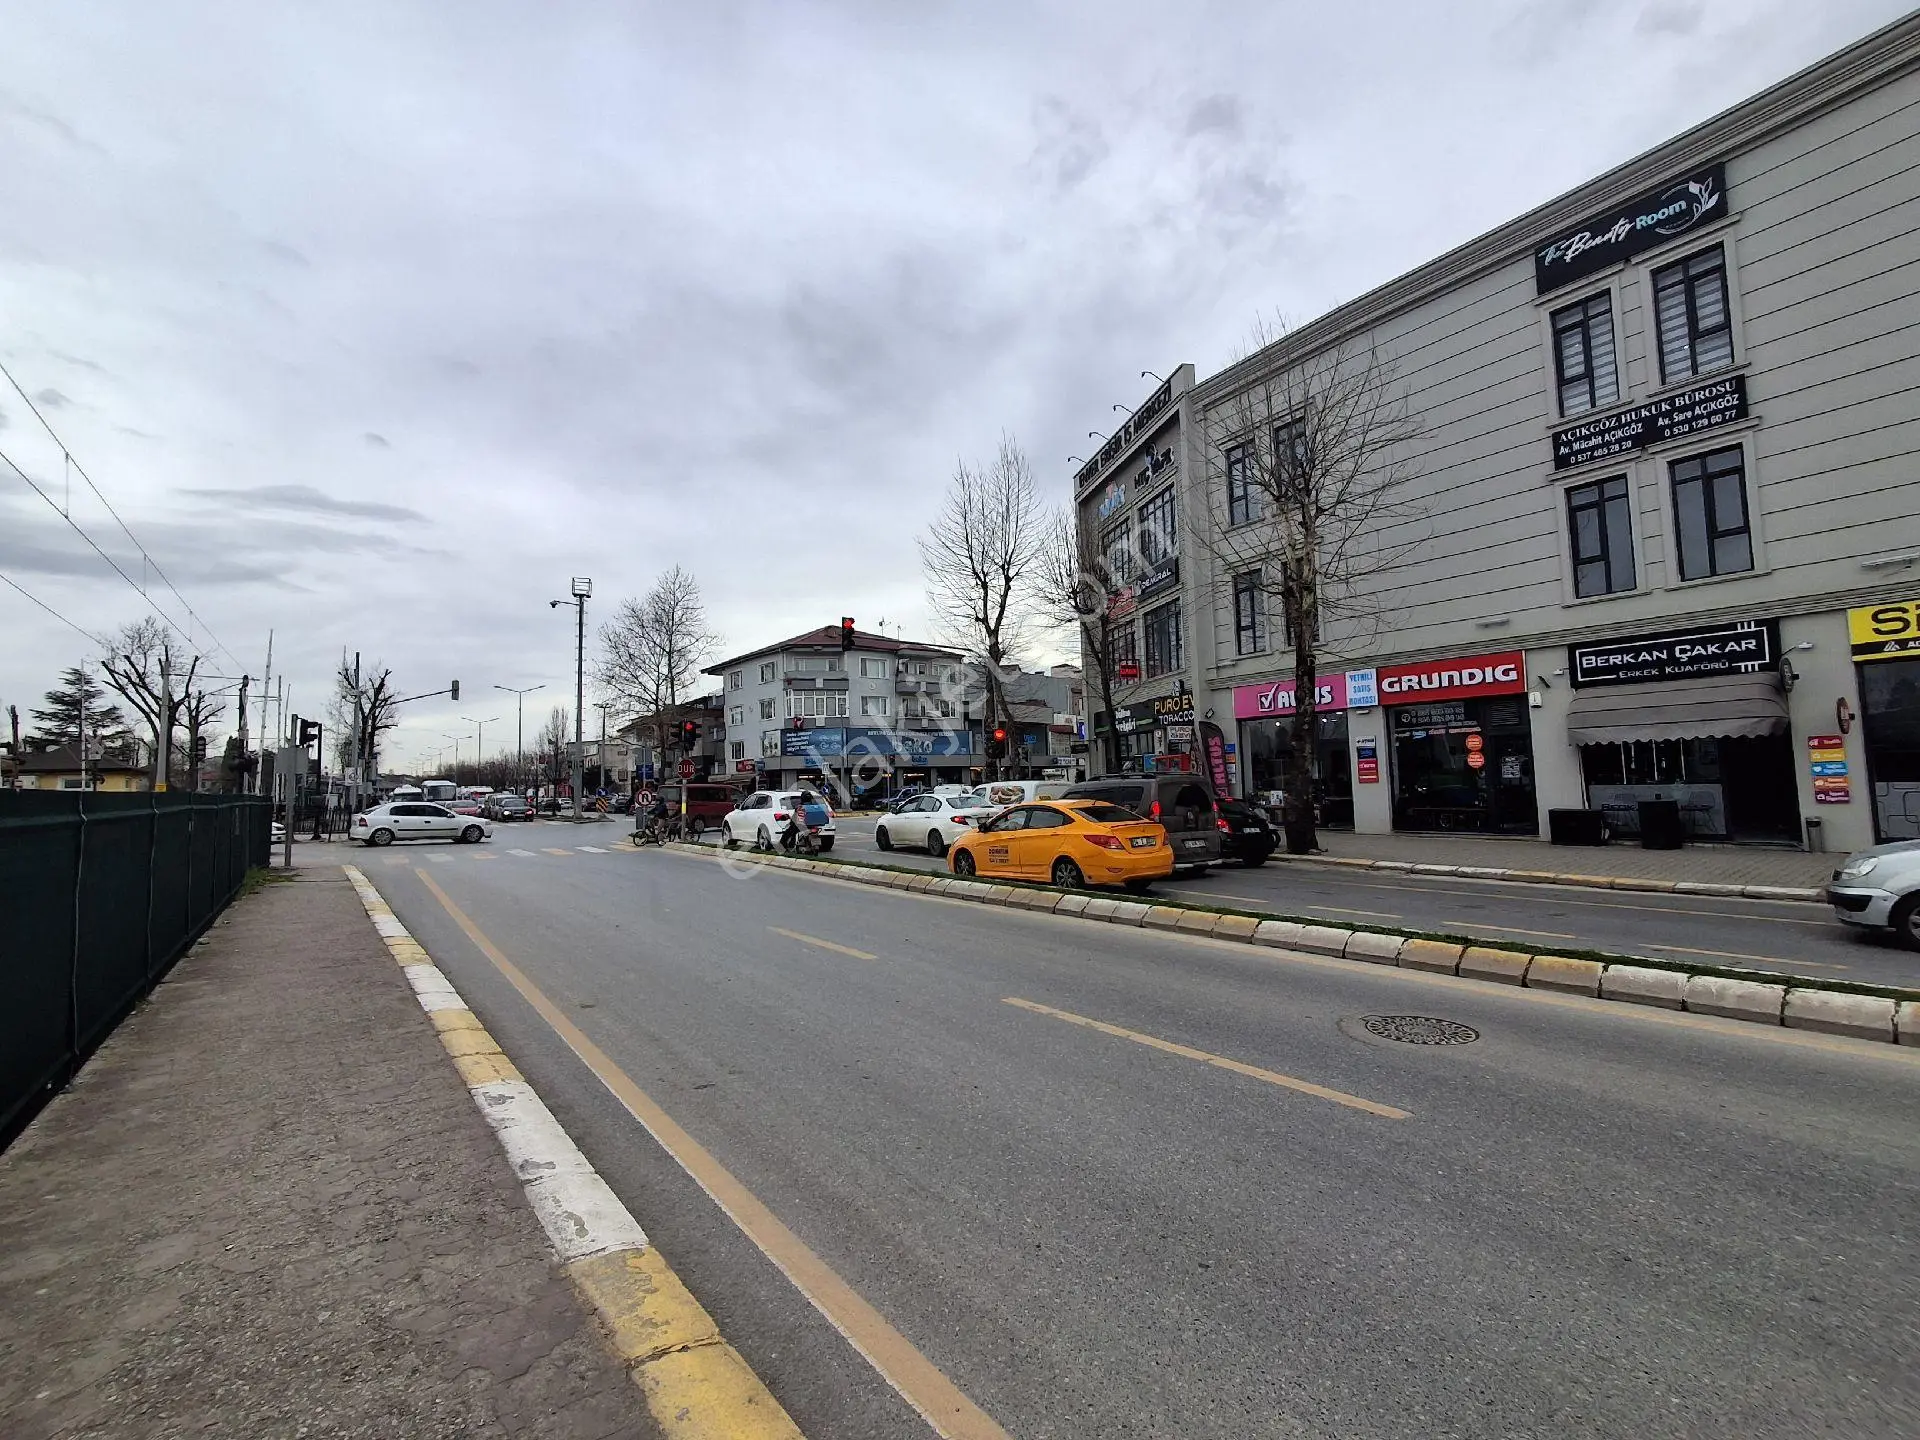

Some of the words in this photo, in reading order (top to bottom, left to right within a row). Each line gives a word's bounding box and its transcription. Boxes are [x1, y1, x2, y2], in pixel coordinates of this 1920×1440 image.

[1560, 217, 1635, 262] Beauty
[1635, 200, 1687, 230] Room
[1559, 416, 1618, 442] AÇIKGÖZ
[1621, 401, 1671, 424] HUKUK
[1675, 379, 1736, 407] BÜROSU
[1657, 416, 1671, 427] Av.
[1694, 394, 1739, 416] AÇIKGÖZ
[1664, 429, 1670, 437] 0
[1673, 424, 1689, 435] 530
[1725, 409, 1737, 419] 77
[1604, 422, 1643, 443] AÇIKGÖZ
[1570, 456, 1576, 464] 0
[1582, 650, 1667, 669] BERKAN
[1674, 639, 1757, 662] ÇAKAR
[1382, 664, 1518, 693] GRUNDIG
[1619, 668, 1659, 679] ERKEK
[1665, 659, 1728, 674] KUAFÖRÜ
[1154, 697, 1180, 714] PURO
[678, 764, 695, 773] DUR
